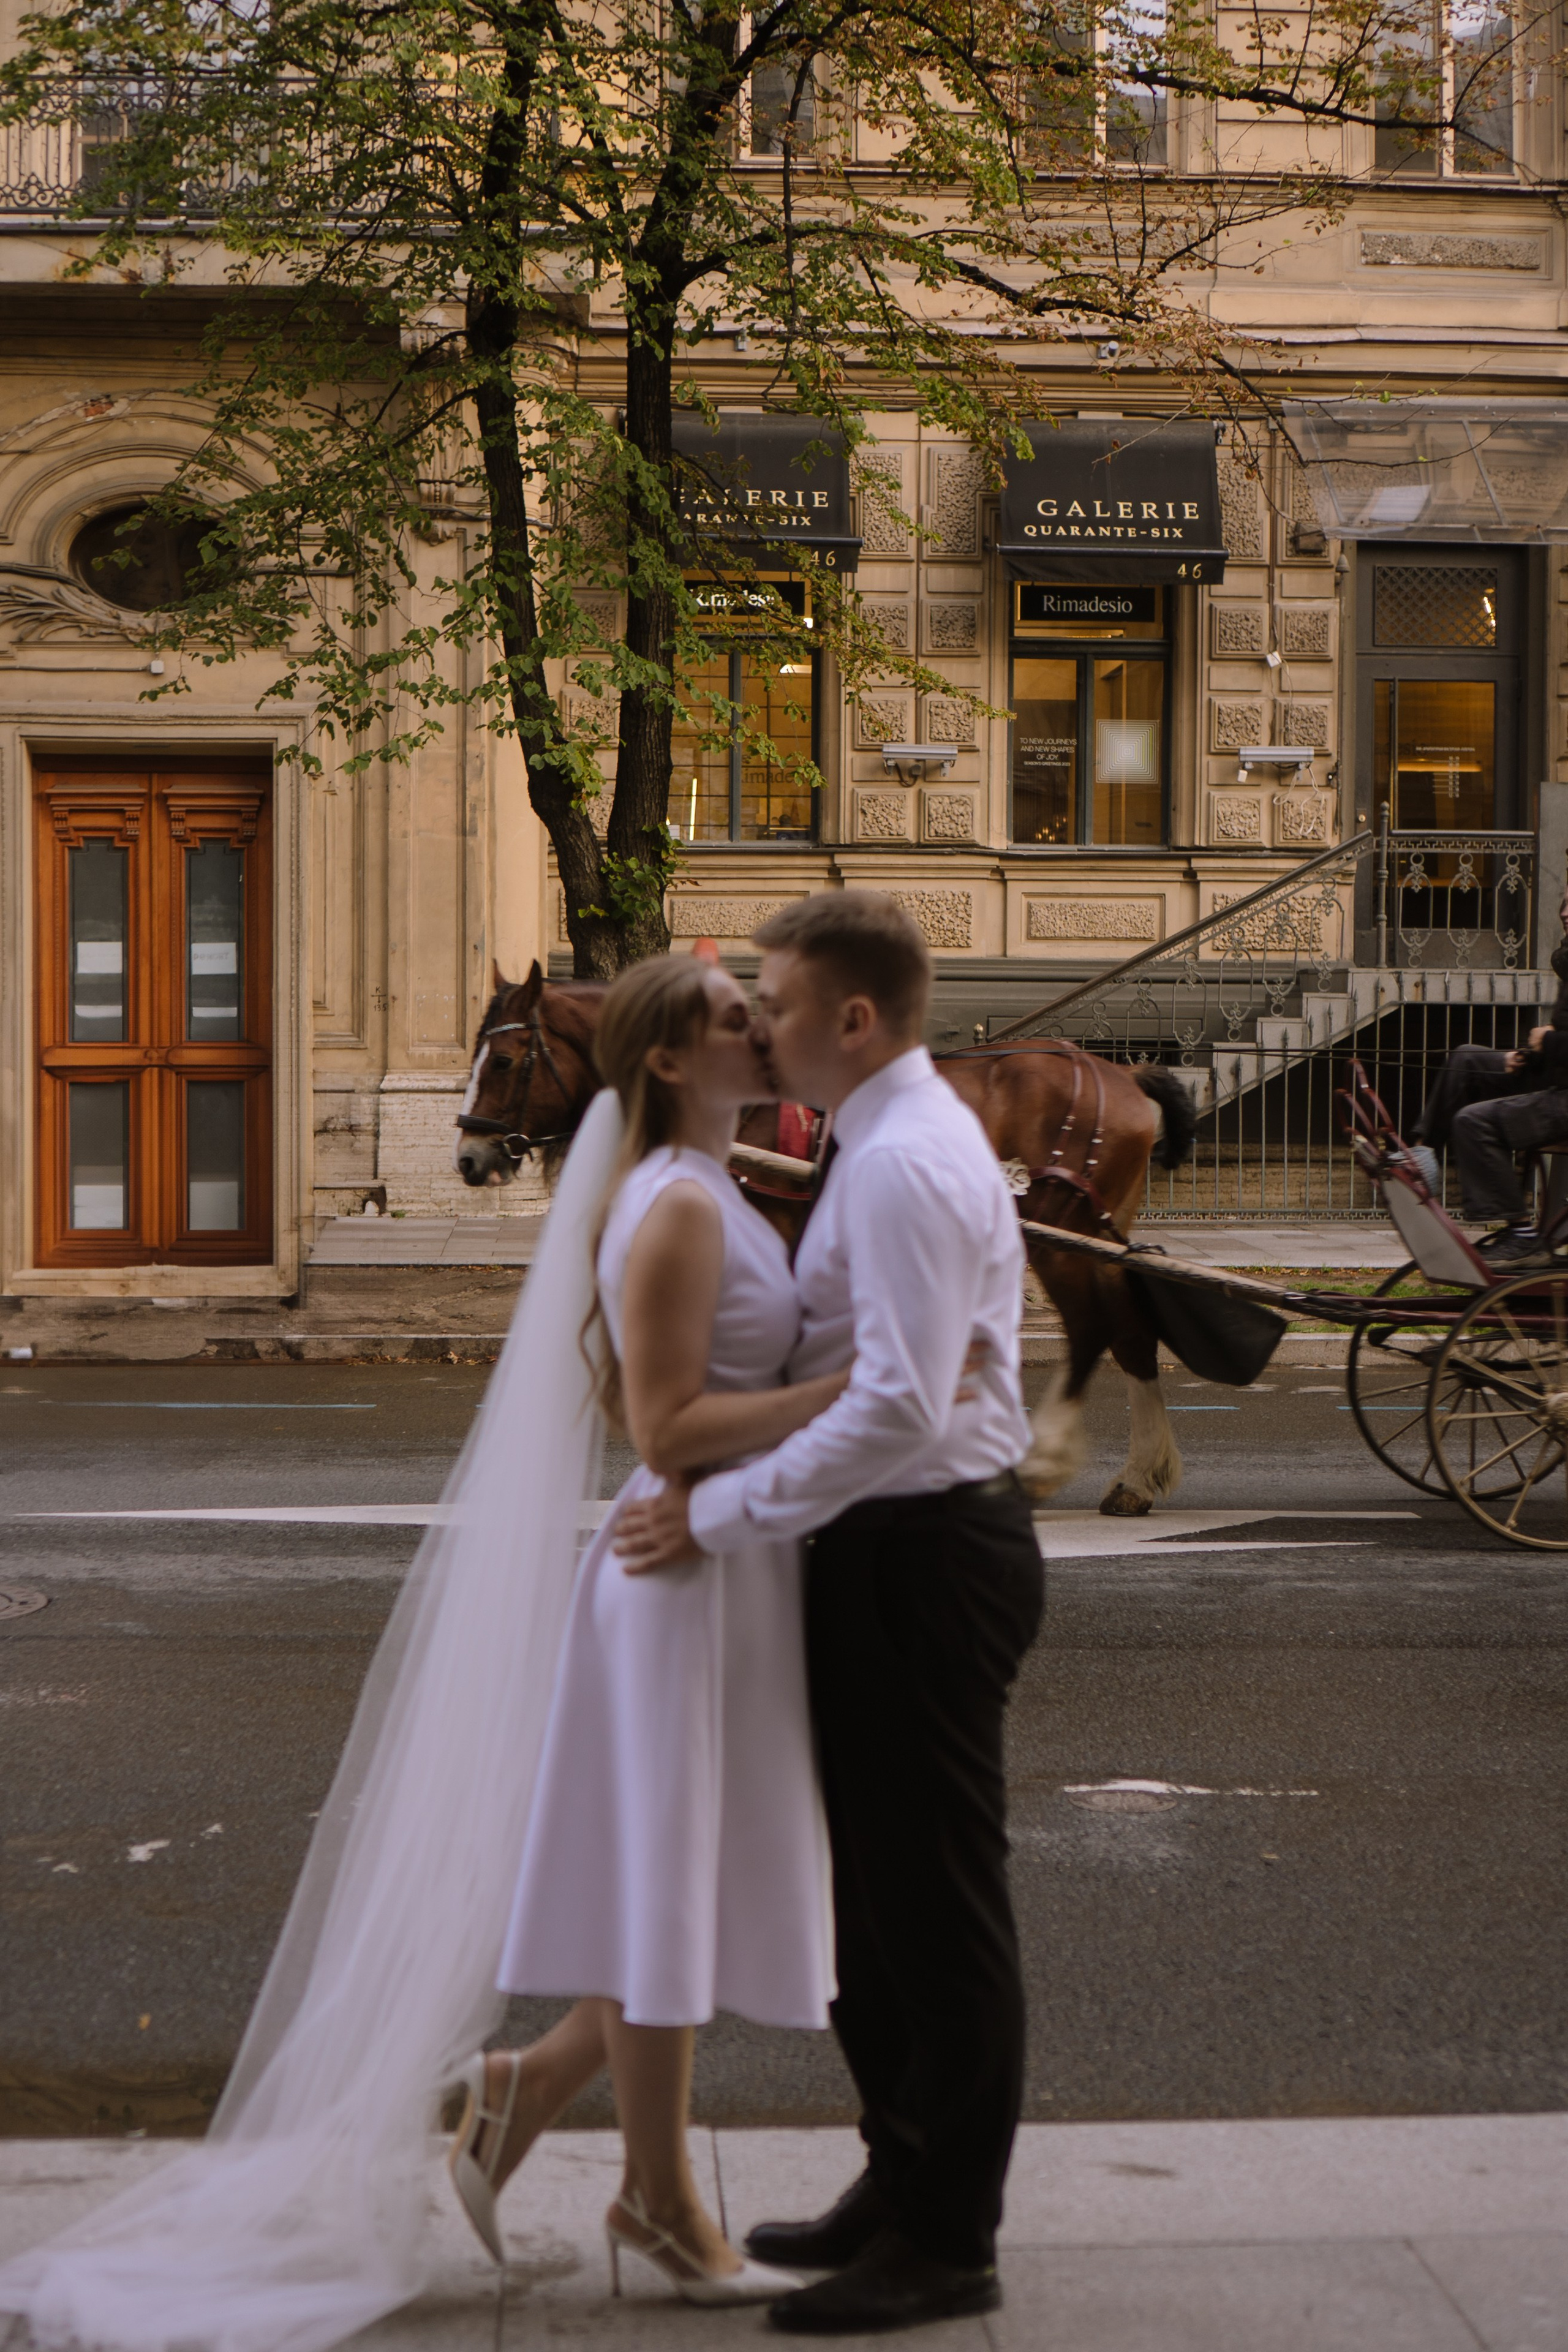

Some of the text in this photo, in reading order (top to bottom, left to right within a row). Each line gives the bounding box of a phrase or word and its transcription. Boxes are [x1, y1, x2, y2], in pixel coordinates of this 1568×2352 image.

[1036, 499, 1199, 519] GALERIE
[1023, 525, 1184, 538] QUARANTE-SIX
[809, 550, 836, 567] 46
[1177, 563, 1202, 579] 46
[1042, 595, 1133, 613] Rimadesio
